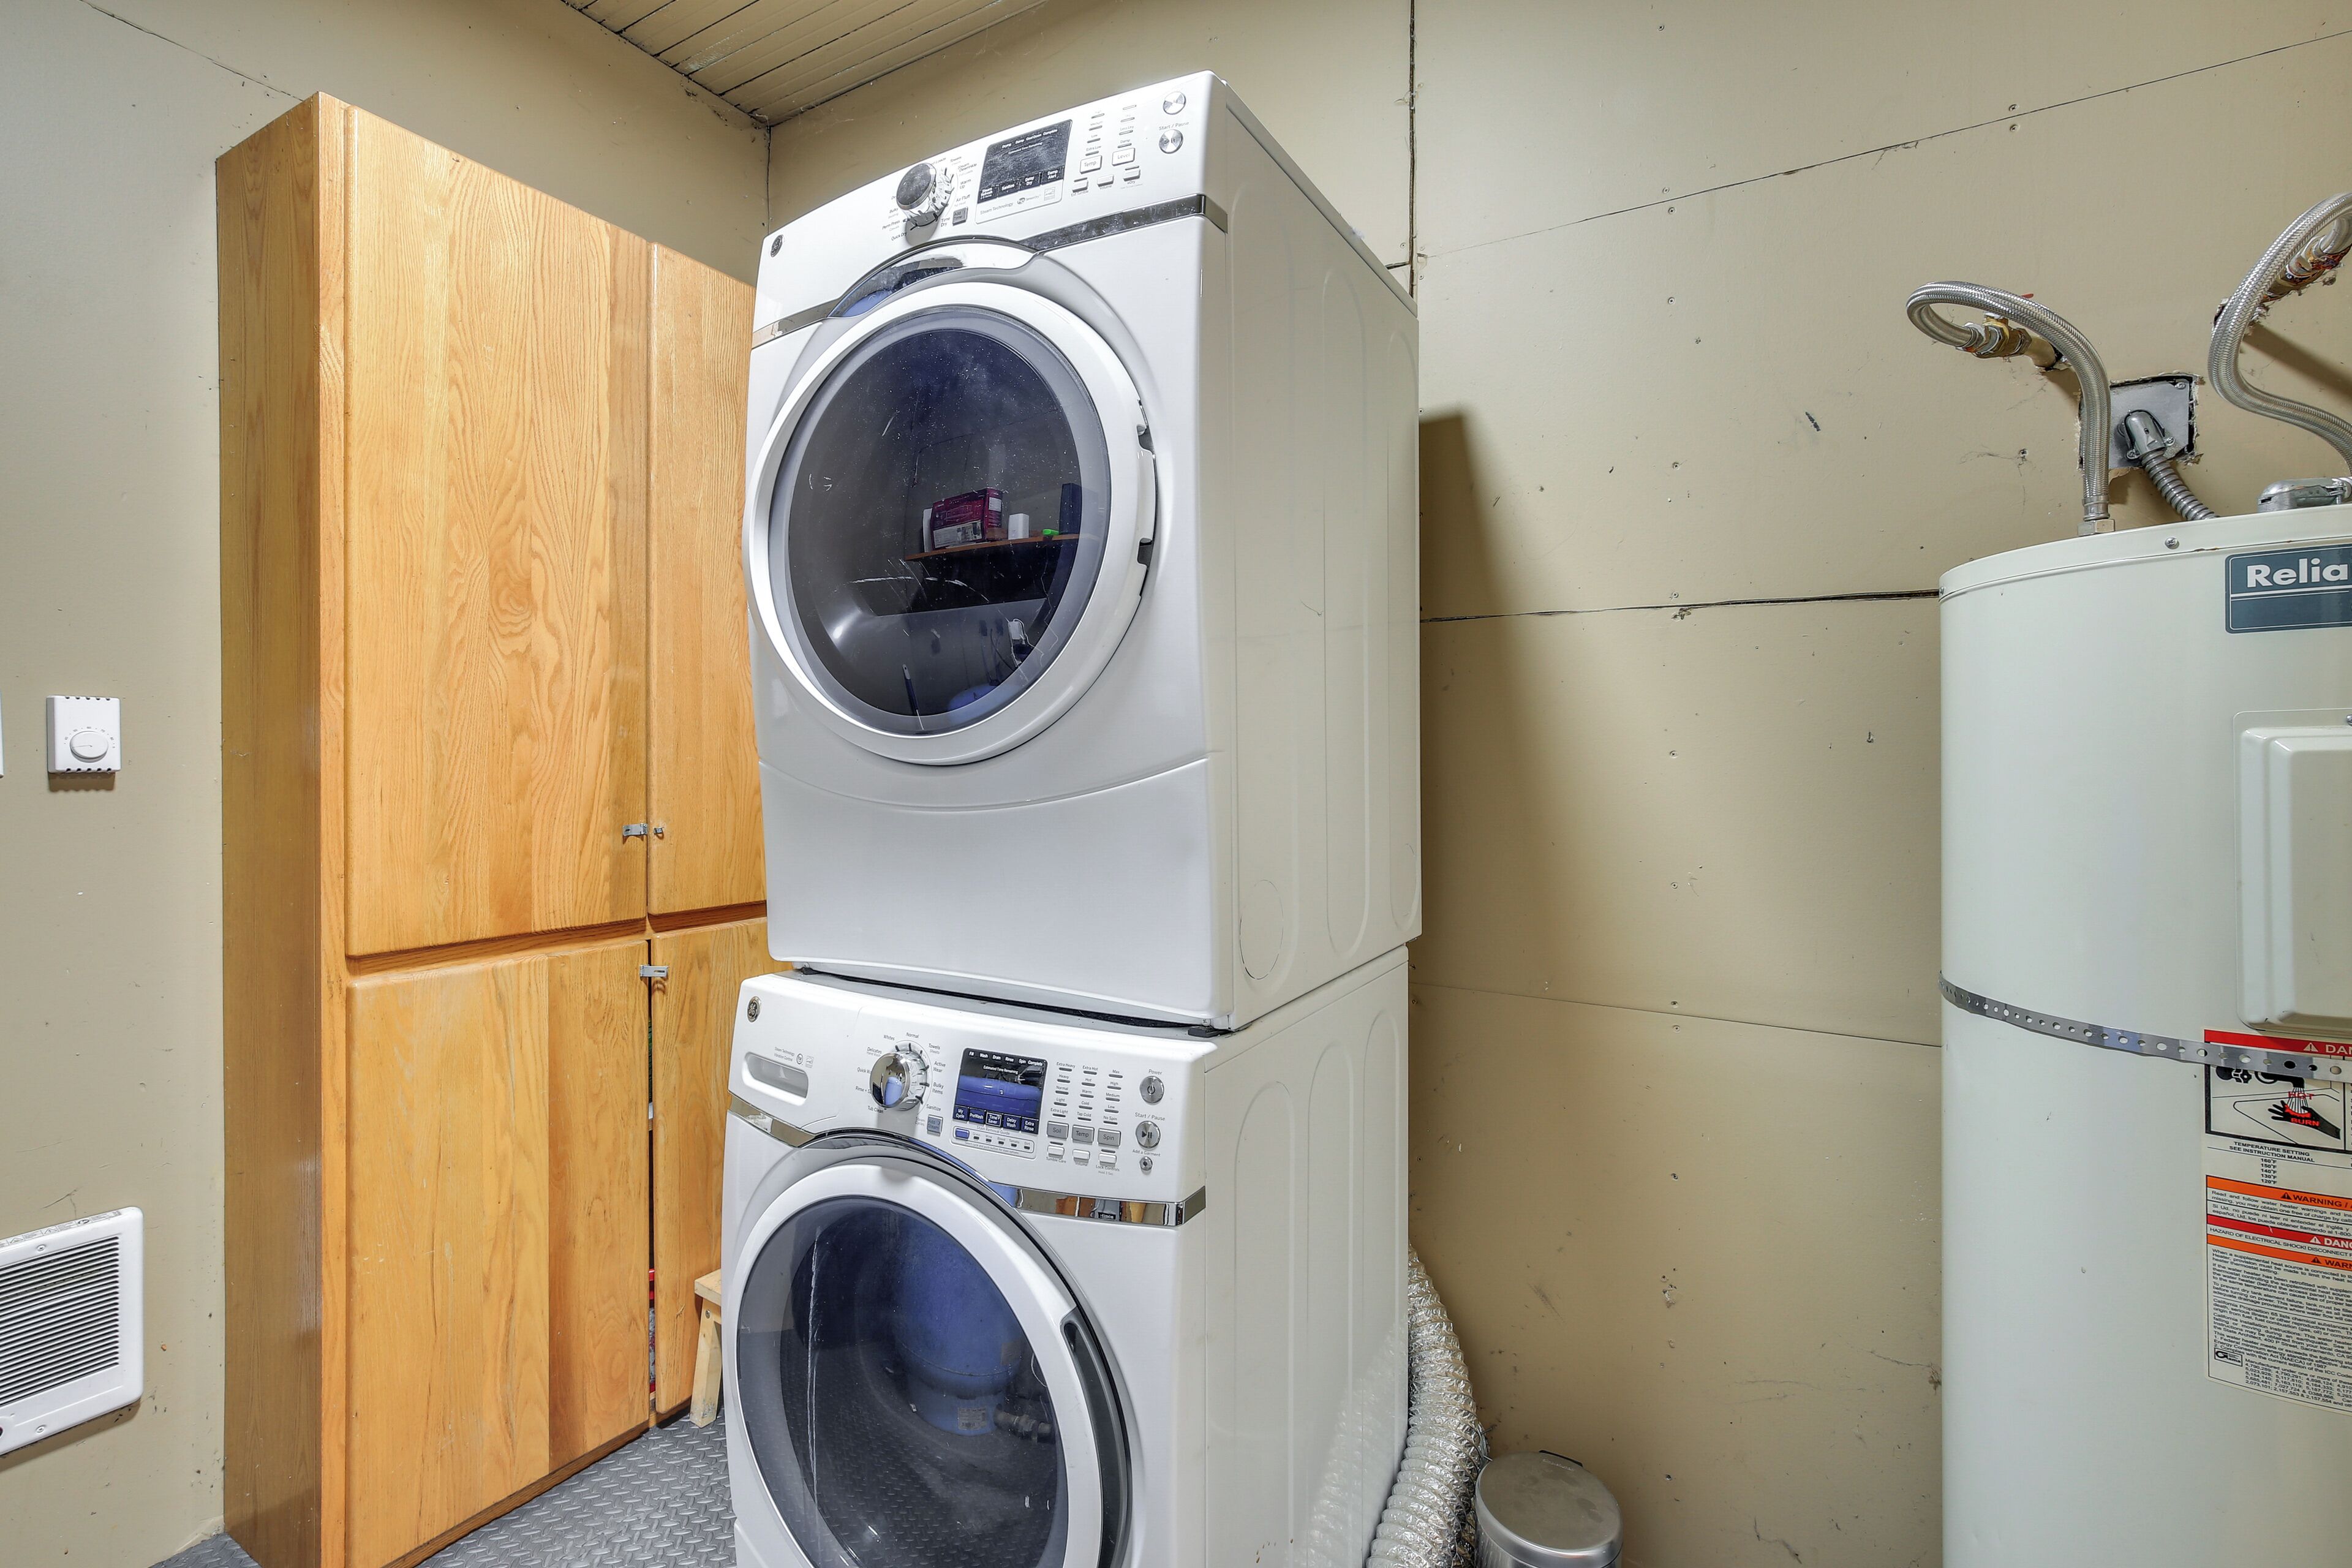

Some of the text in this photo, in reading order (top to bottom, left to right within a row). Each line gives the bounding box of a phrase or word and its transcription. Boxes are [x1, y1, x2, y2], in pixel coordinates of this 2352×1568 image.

[2247, 558, 2348, 588] Relia
[2288, 1091, 2314, 1100] HOT
[2291, 1118, 2320, 1127] BURN
[2234, 1141, 2281, 1152] TEMPERATURE
[2243, 1148, 2286, 1158] INSTRUCTION
[2293, 1194, 2342, 1207] WARNING
[2210, 1227, 2234, 1236] HAZARD
[2245, 1234, 2282, 1245] ELECTRICAL
[2308, 1246, 2348, 1256] DISCONNECT
[2213, 1298, 2238, 1308] California
[2239, 1305, 2269, 1315] Proposition
[2292, 1316, 2316, 1325] chemical
[2318, 1322, 2349, 1330] substances
